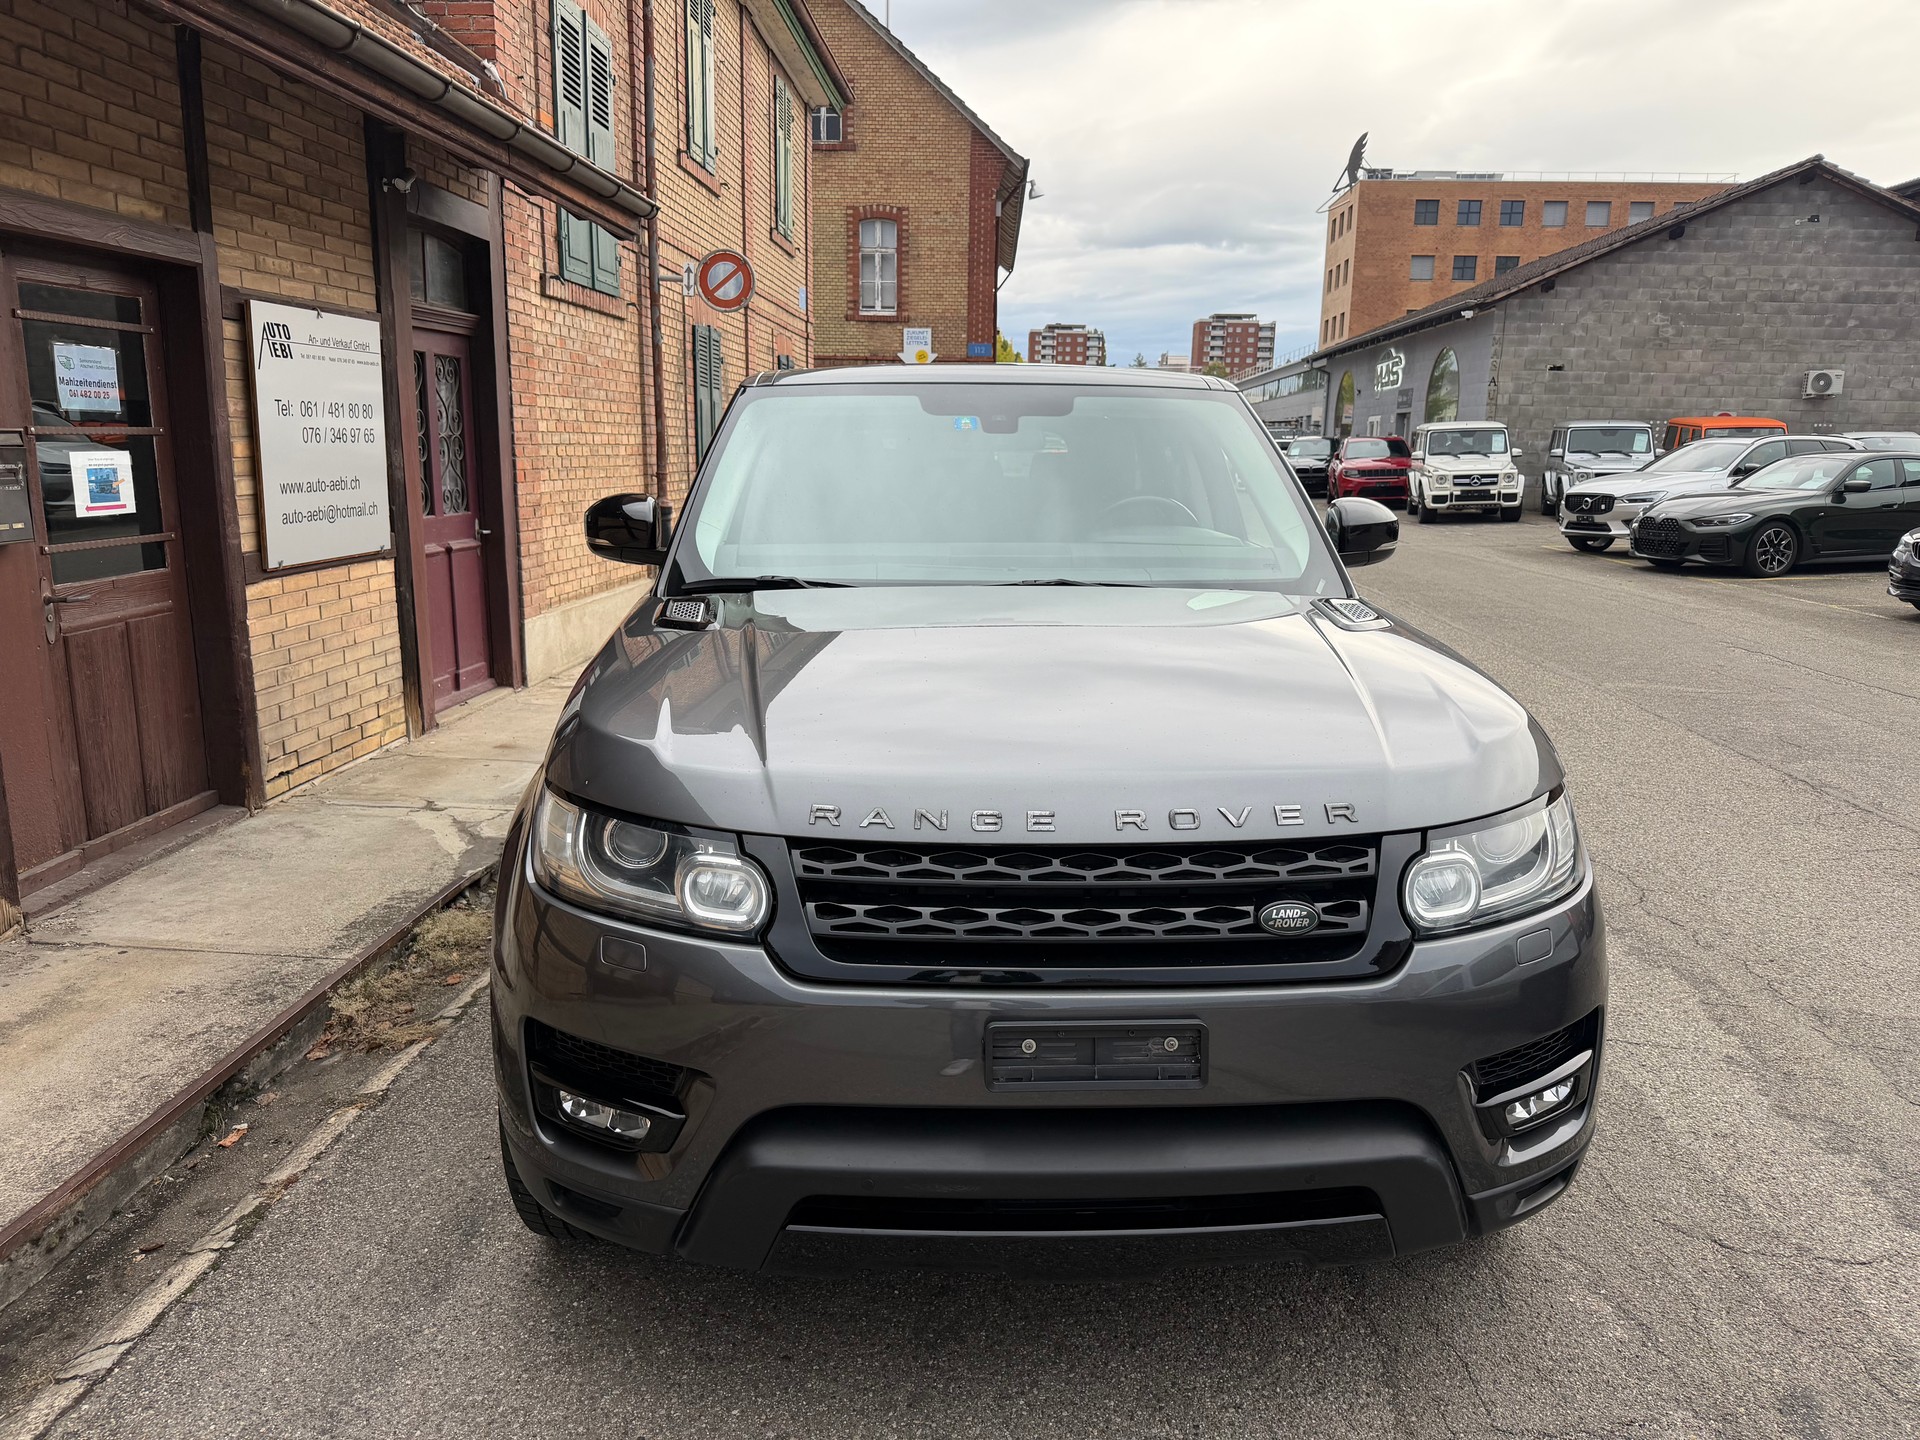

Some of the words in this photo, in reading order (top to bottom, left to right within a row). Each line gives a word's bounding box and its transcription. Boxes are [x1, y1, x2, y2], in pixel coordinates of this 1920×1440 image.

[308, 334, 319, 345] An-
[320, 337, 331, 347] und
[332, 337, 352, 349] Verkauf
[353, 340, 371, 351] GmbH
[974, 346, 985, 354] 112
[58, 376, 117, 389] Mahlzeitendienst
[68, 389, 79, 398] 061
[80, 389, 92, 399] 482
[102, 391, 111, 400] 25
[274, 399, 294, 417] Tel:
[300, 400, 318, 418] 061
[328, 402, 345, 419] 481
[348, 403, 360, 419] 80
[362, 403, 373, 419] 80
[302, 426, 321, 444] 076
[329, 427, 348, 444] 346
[349, 427, 361, 444] 97
[363, 428, 375, 444] 65
[279, 475, 361, 495] www.auto-aebi.ch
[281, 501, 379, 525] auto-aebi@hotmail.ch
[808, 803, 1056, 832] RANGE
[1115, 802, 1358, 831] ROVER
[1271, 909, 1301, 919] LAND
[1274, 918, 1310, 928] ROVER
